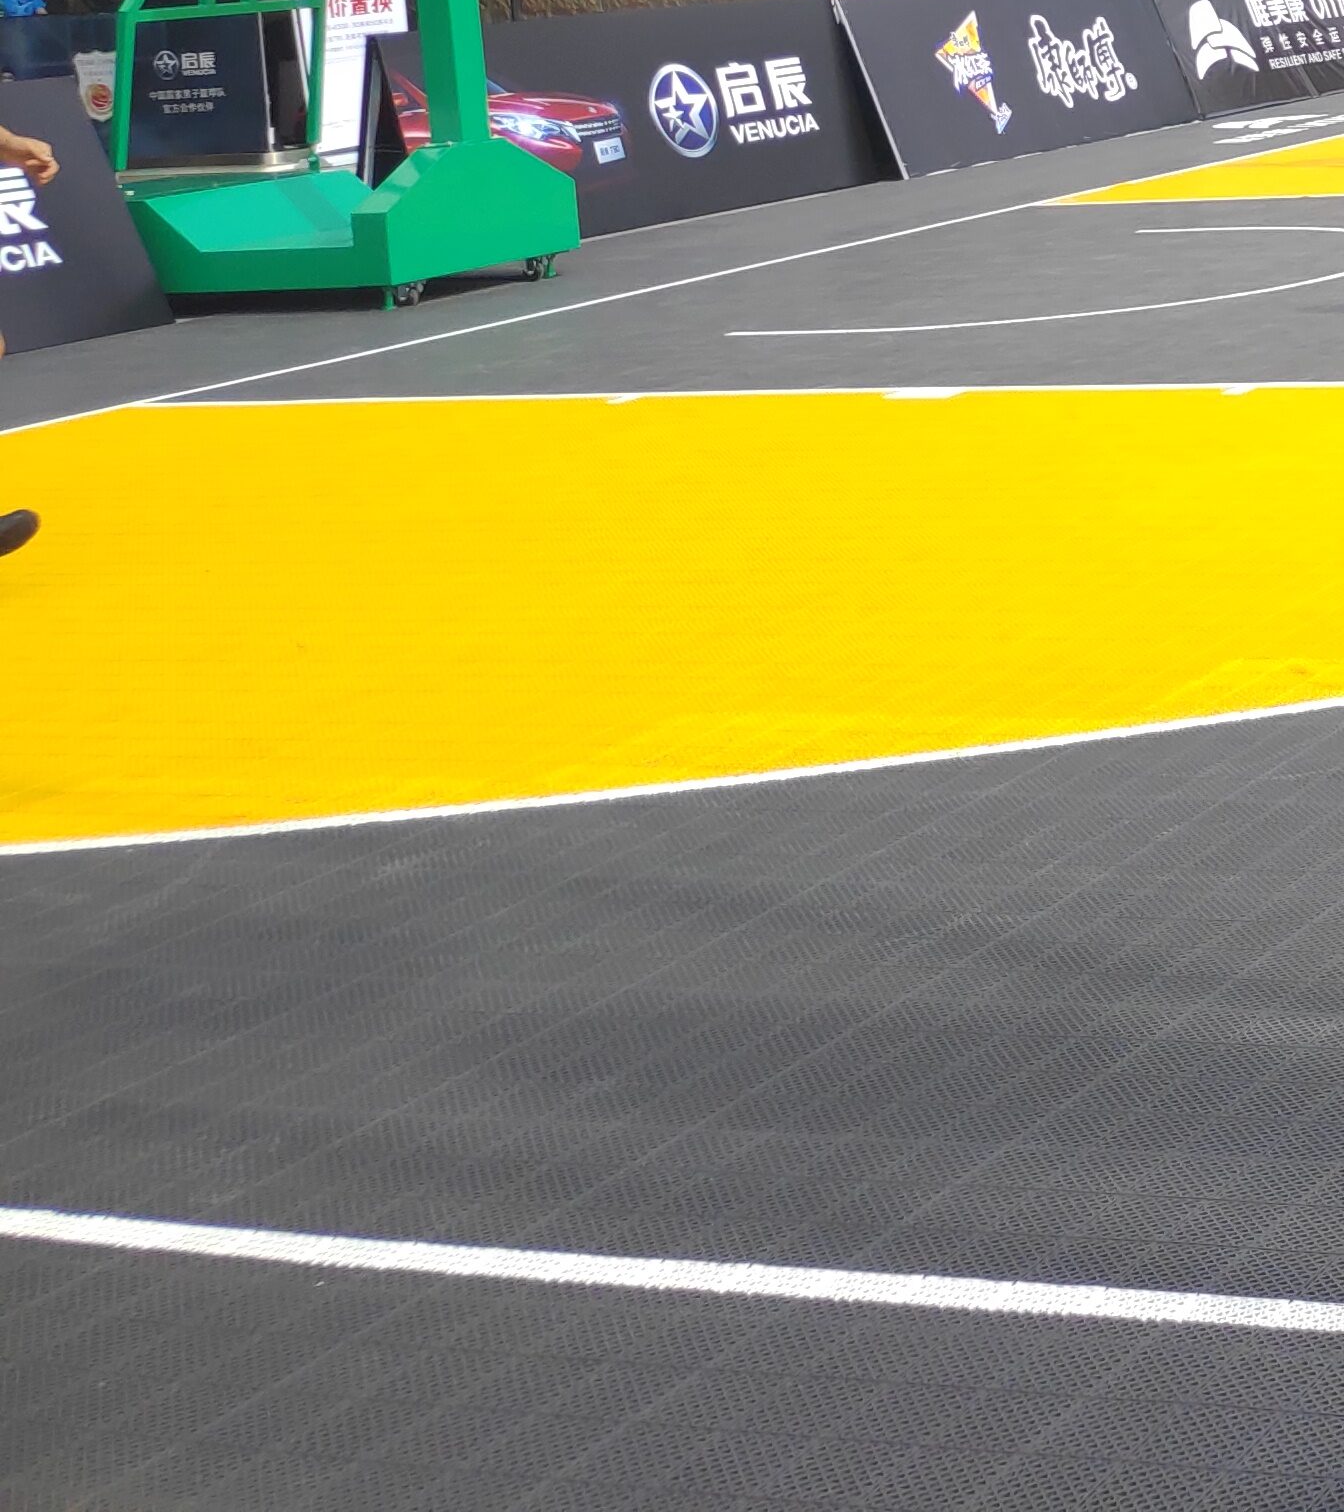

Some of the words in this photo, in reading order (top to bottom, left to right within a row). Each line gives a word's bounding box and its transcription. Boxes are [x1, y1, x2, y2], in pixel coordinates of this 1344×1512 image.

[181, 51, 217, 70] 启辰
[1268, 52, 1309, 70] RESILIENT
[1309, 50, 1324, 65] AND
[1325, 48, 1342, 62] SAFE
[715, 56, 813, 119] 启辰
[730, 113, 820, 145] VENUCIA
